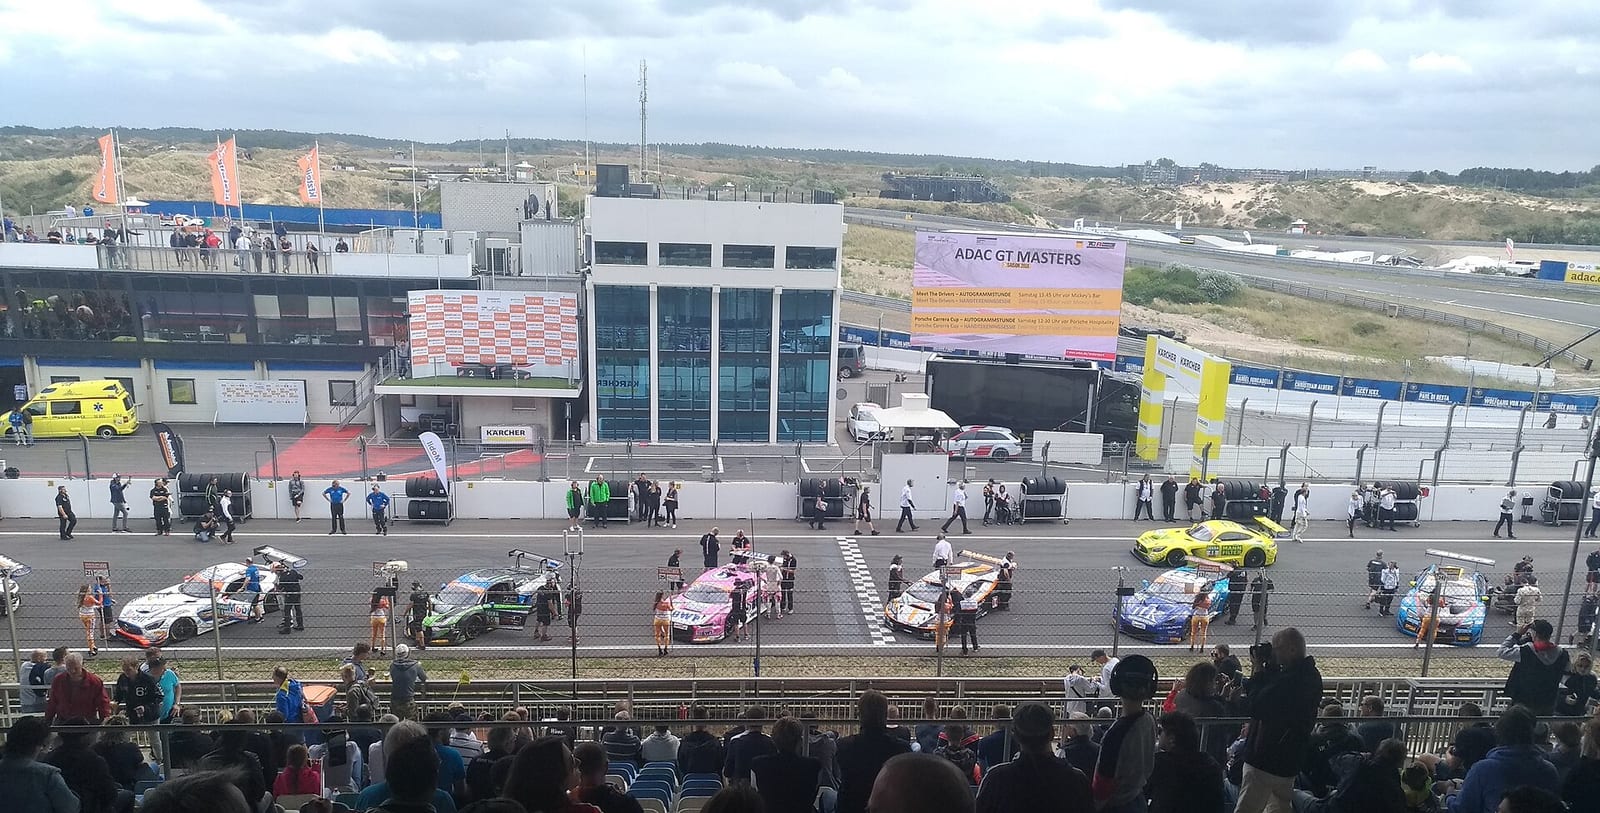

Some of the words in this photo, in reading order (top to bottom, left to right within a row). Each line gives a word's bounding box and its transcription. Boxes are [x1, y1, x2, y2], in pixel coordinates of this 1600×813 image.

[955, 247, 993, 261] ADAC
[995, 249, 1014, 262] GT
[1016, 251, 1082, 266] MASTERS
